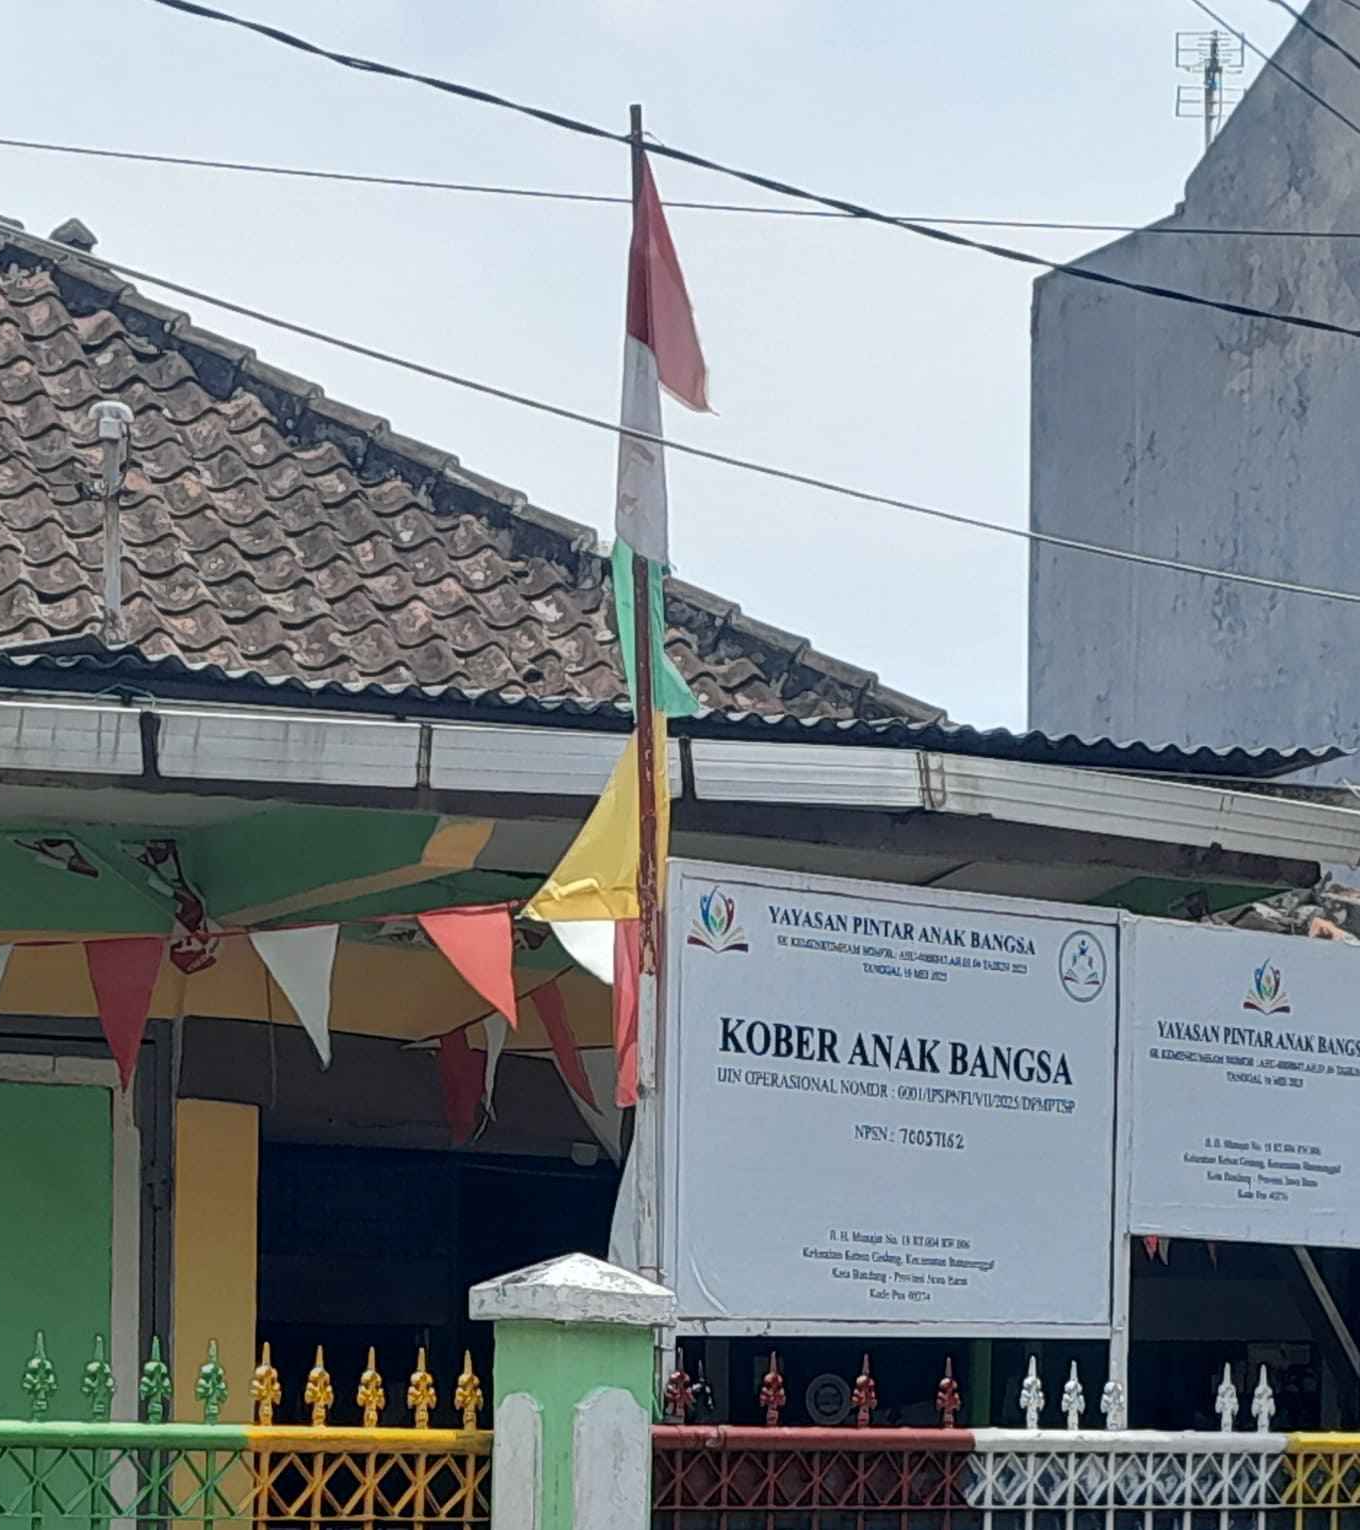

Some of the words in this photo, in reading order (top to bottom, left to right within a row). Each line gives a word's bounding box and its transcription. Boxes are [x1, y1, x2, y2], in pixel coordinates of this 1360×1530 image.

[768, 905, 847, 932] YAYASAN
[853, 916, 914, 941] PINTAR
[918, 926, 966, 947] ANAK
[971, 931, 1036, 955] BANGSA
[719, 1017, 839, 1064] KOBER
[848, 1031, 941, 1074] ANAK
[949, 1041, 1073, 1086] BANGSA
[1157, 1020, 1220, 1043] YAYASAN
[1224, 1027, 1275, 1049] PINTAR
[1273, 1033, 1314, 1053] ANAK
[745, 1070, 837, 1094] OPERASIONAL
[840, 1079, 888, 1099] NOMOR
